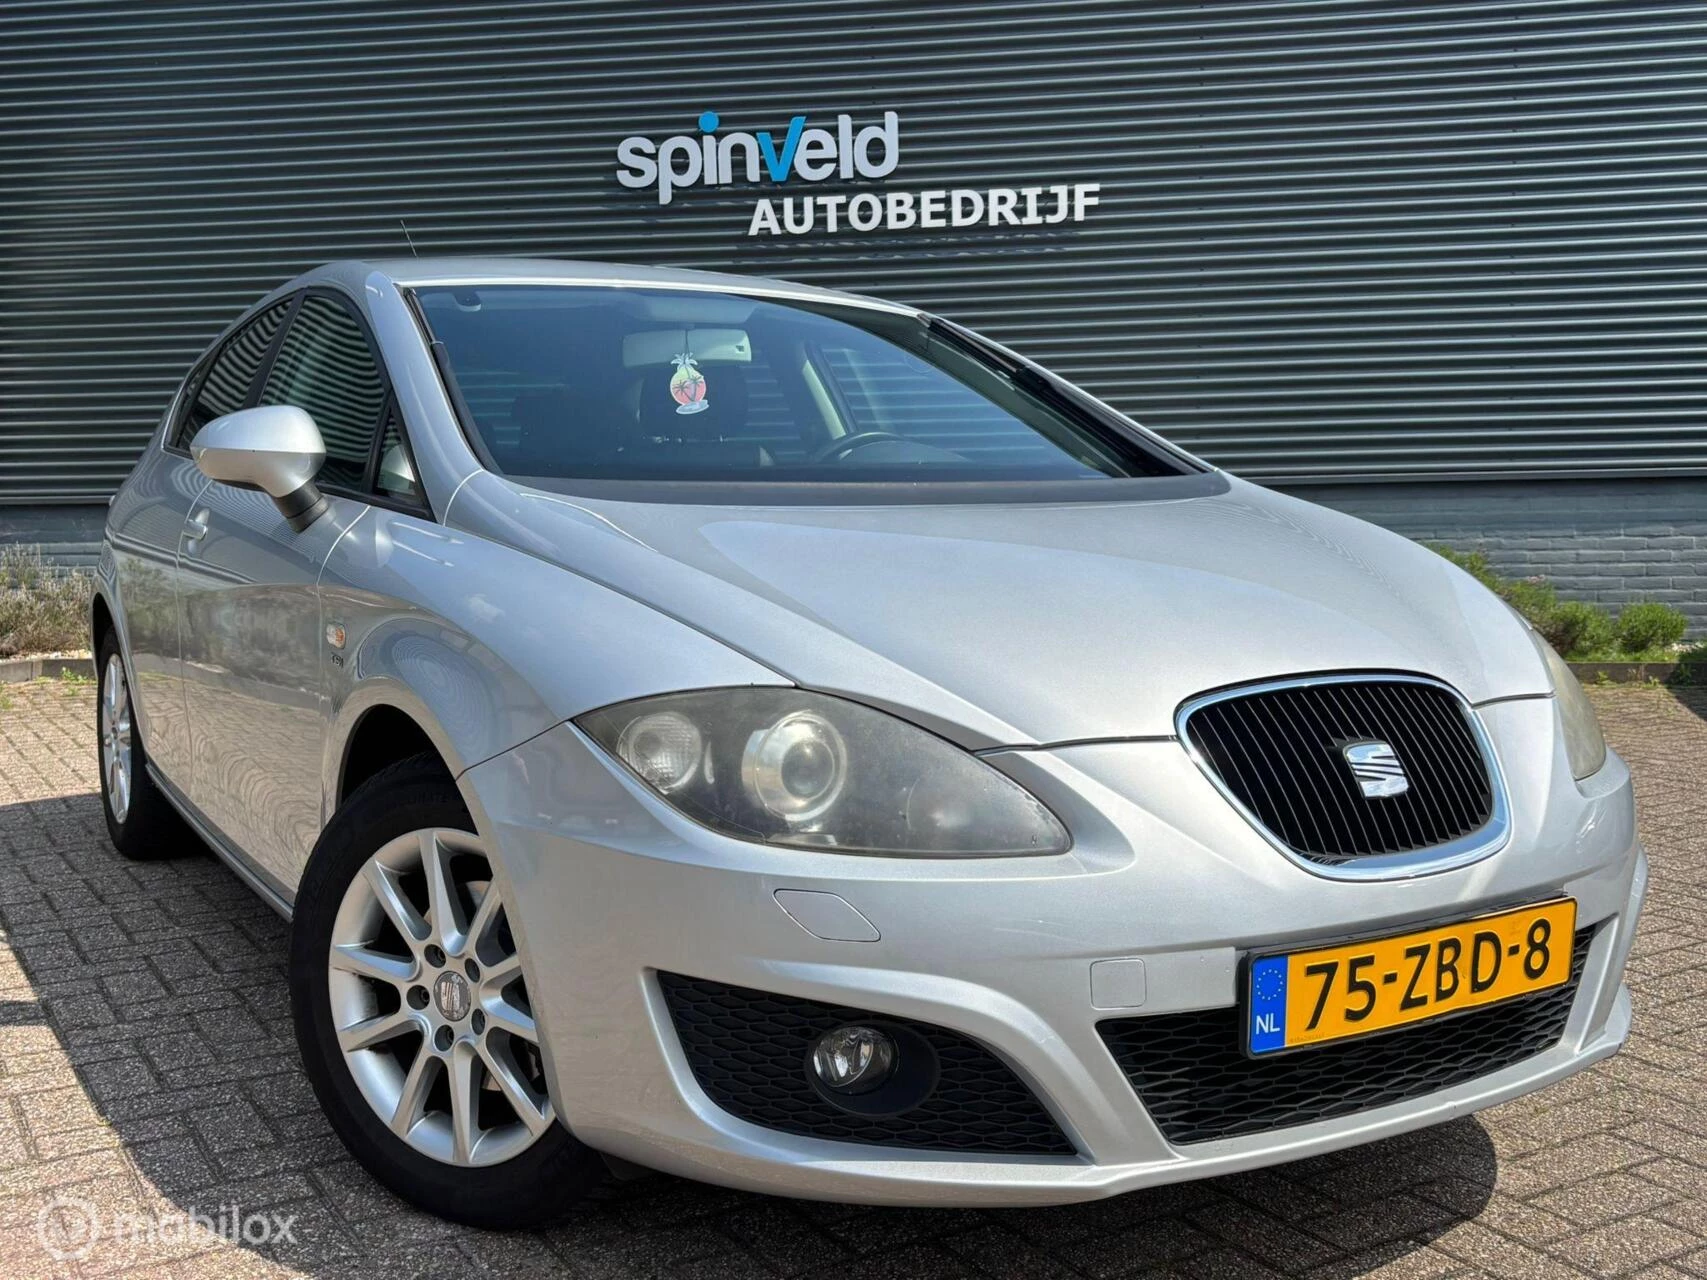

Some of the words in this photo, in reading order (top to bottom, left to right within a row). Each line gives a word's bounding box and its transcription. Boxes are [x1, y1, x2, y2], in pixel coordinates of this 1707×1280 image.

[748, 183, 1100, 236] AUTOBEDRIJF
[1304, 918, 1551, 1031] 75-ZBD-8
[1255, 1013, 1280, 1035] NL
